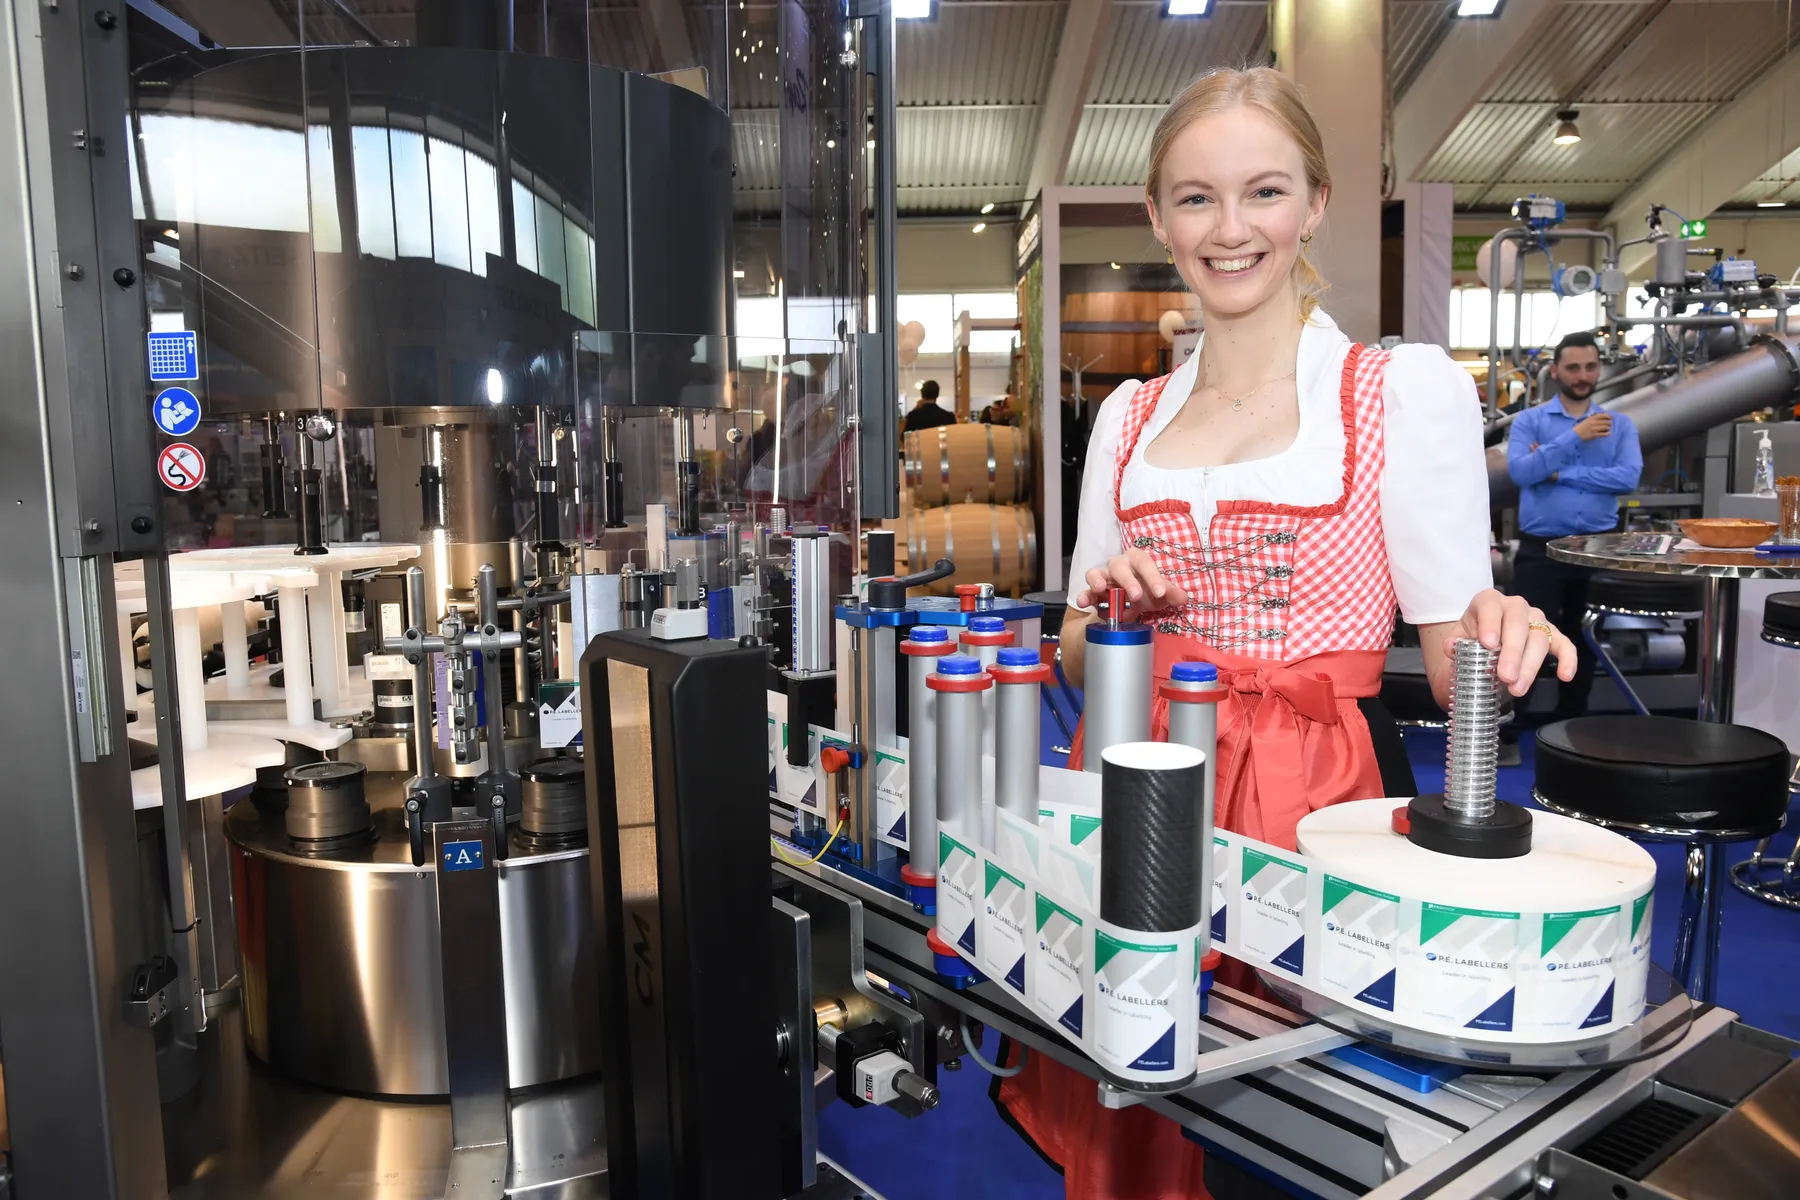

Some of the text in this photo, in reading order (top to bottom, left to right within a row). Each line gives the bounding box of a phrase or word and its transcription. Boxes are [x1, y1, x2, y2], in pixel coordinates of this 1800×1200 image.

[297, 417, 304, 430] 3
[564, 414, 573, 424] 4
[455, 848, 473, 865] A
[951, 882, 973, 901] LABELLERS
[1253, 895, 1300, 918] P.E. LABELLERS
[999, 915, 1024, 935] LABELLERS
[1336, 925, 1390, 950] P.E. LABELLERS
[632, 911, 654, 1009] CM
[1053, 951, 1080, 974] LABELLERS
[1438, 955, 1509, 970] P.E. LABELLERS
[1558, 956, 1613, 971] P.E. LABELLERS
[1105, 987, 1169, 1007] P.E. LABELLERS
